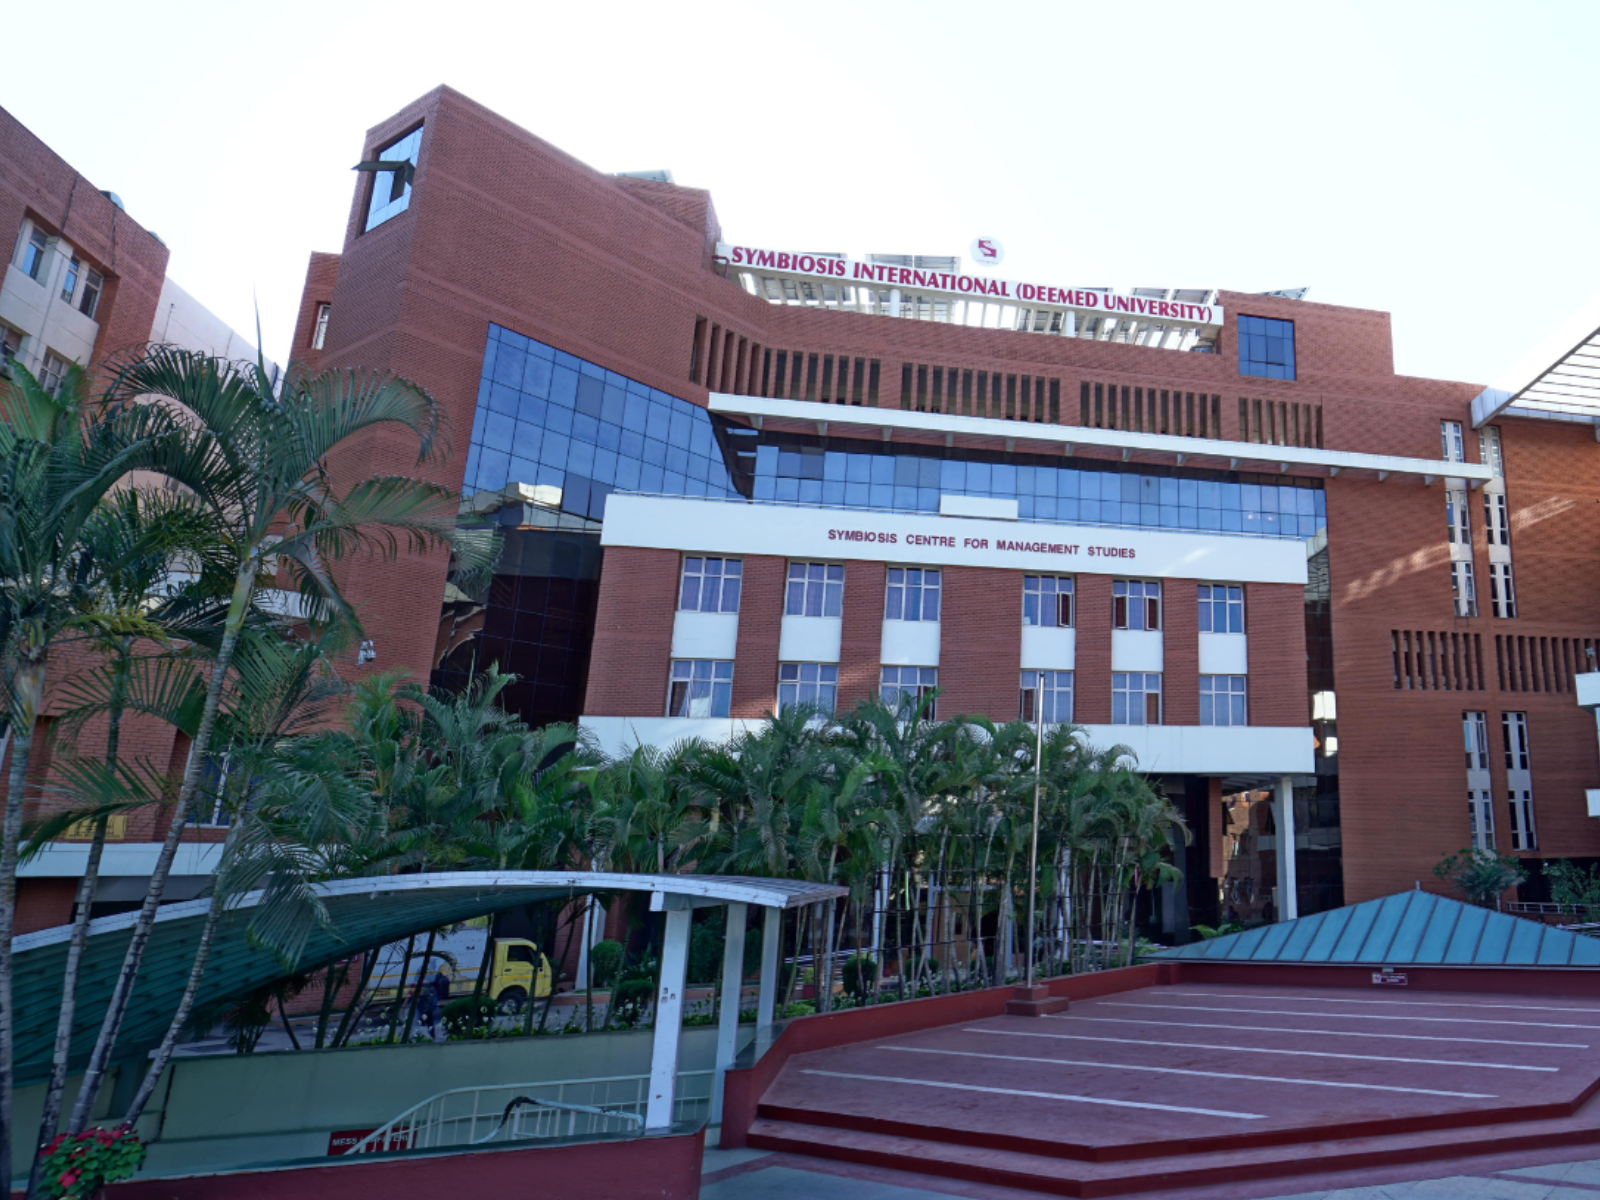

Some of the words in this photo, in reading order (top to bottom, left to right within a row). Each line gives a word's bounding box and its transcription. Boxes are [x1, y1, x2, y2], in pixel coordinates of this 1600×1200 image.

[731, 245, 846, 277] SYMBIOSIS
[853, 262, 1010, 297] INTERNATIONAL
[1016, 282, 1099, 308] (DEEMED
[1103, 294, 1213, 323] UNIVERSITY)
[828, 529, 898, 544] SYMBIOSIS
[906, 534, 956, 548] CENTRE
[963, 537, 989, 550] FOR
[996, 539, 1080, 556] MANAGEMENT
[1087, 546, 1136, 559] STUDIES
[332, 1137, 357, 1146] MESS
